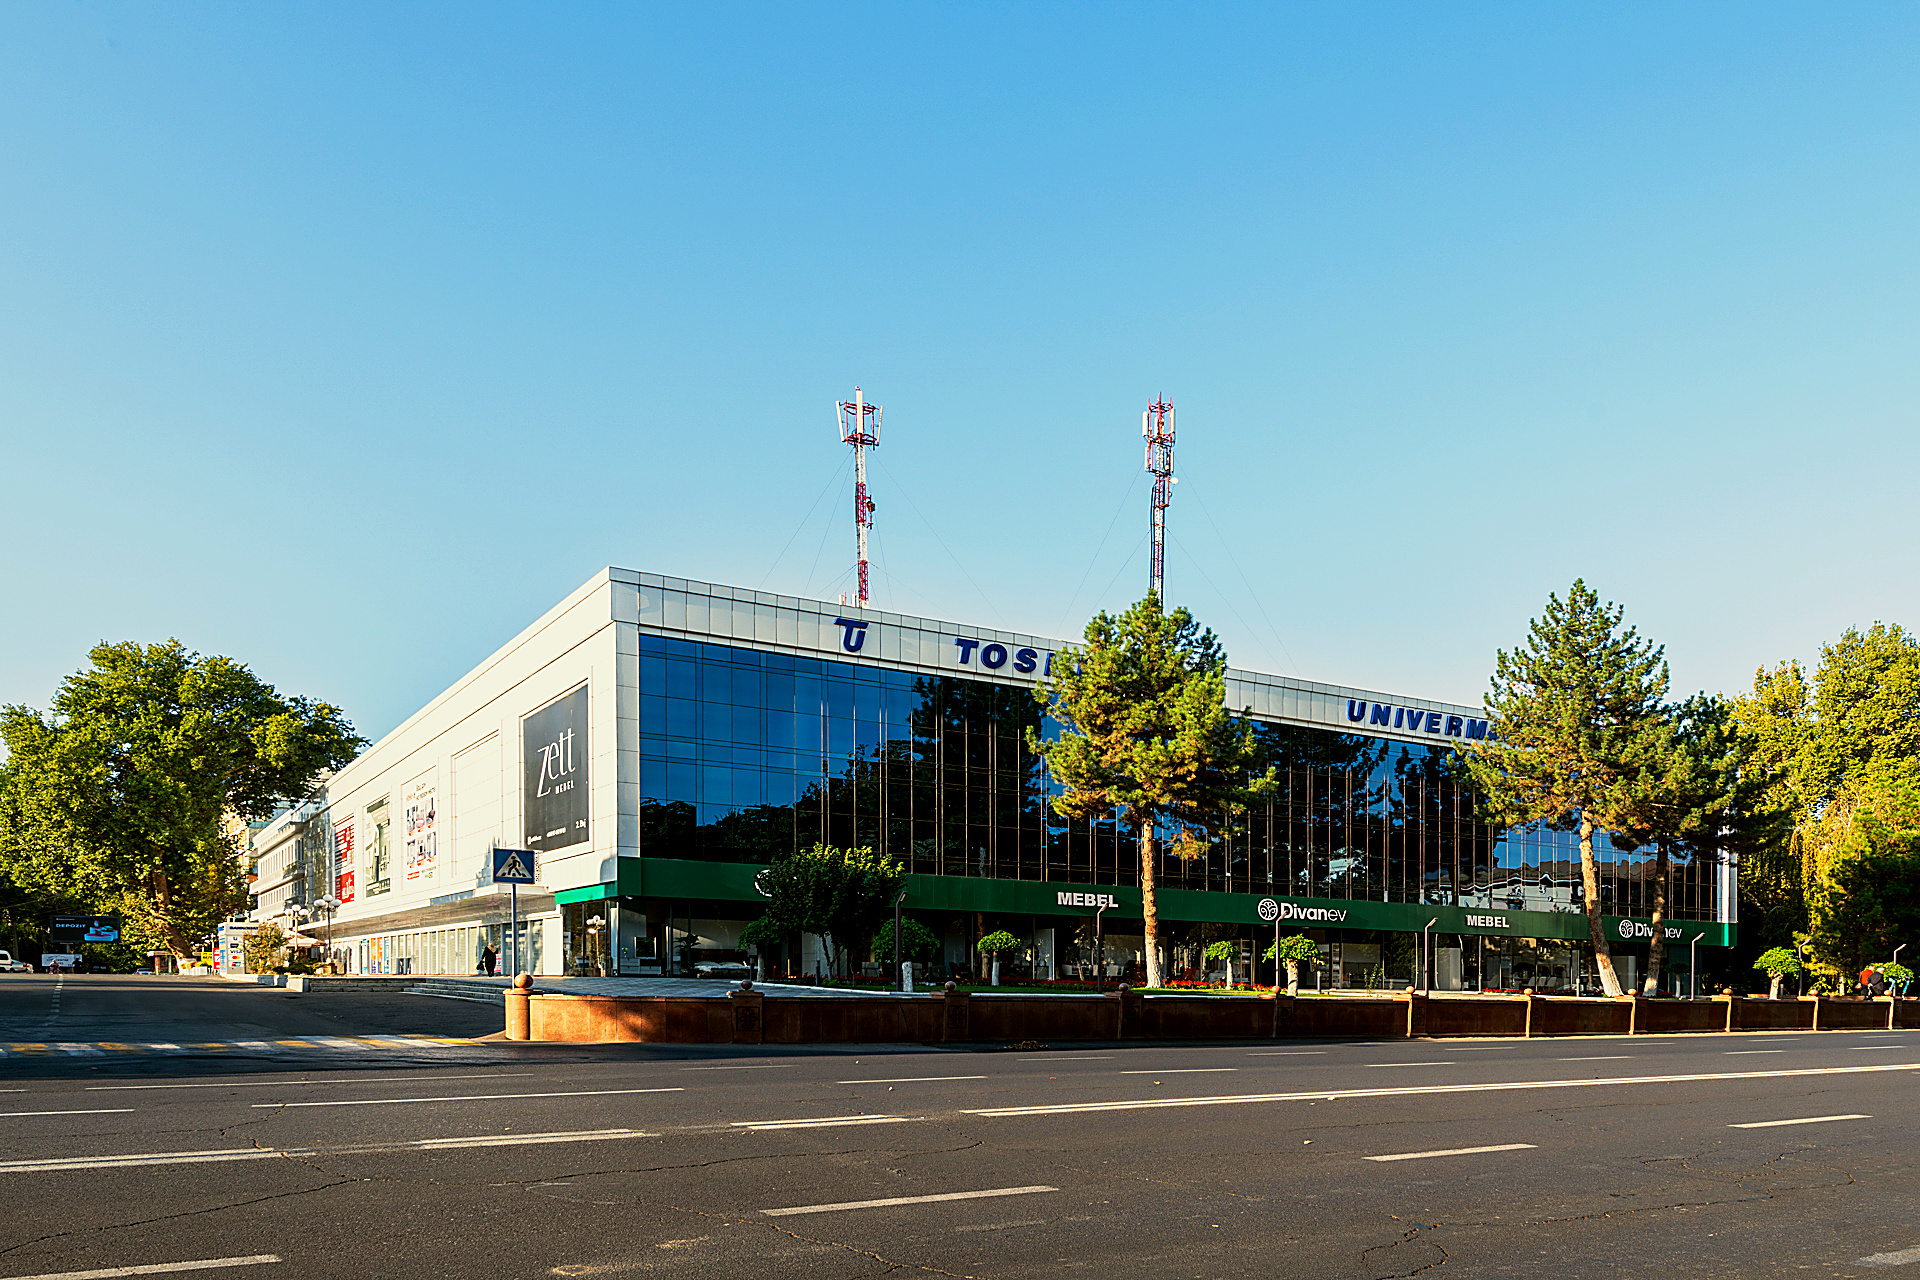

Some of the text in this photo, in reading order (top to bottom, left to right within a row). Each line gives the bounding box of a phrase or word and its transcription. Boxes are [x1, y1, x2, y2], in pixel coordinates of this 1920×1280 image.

[954, 637, 1082, 677] TOS
[1057, 891, 1119, 908] MEBEL
[1280, 902, 1347, 922] Divanev
[1465, 914, 1510, 928] MEBEL
[1634, 922, 1683, 939] Divnev
